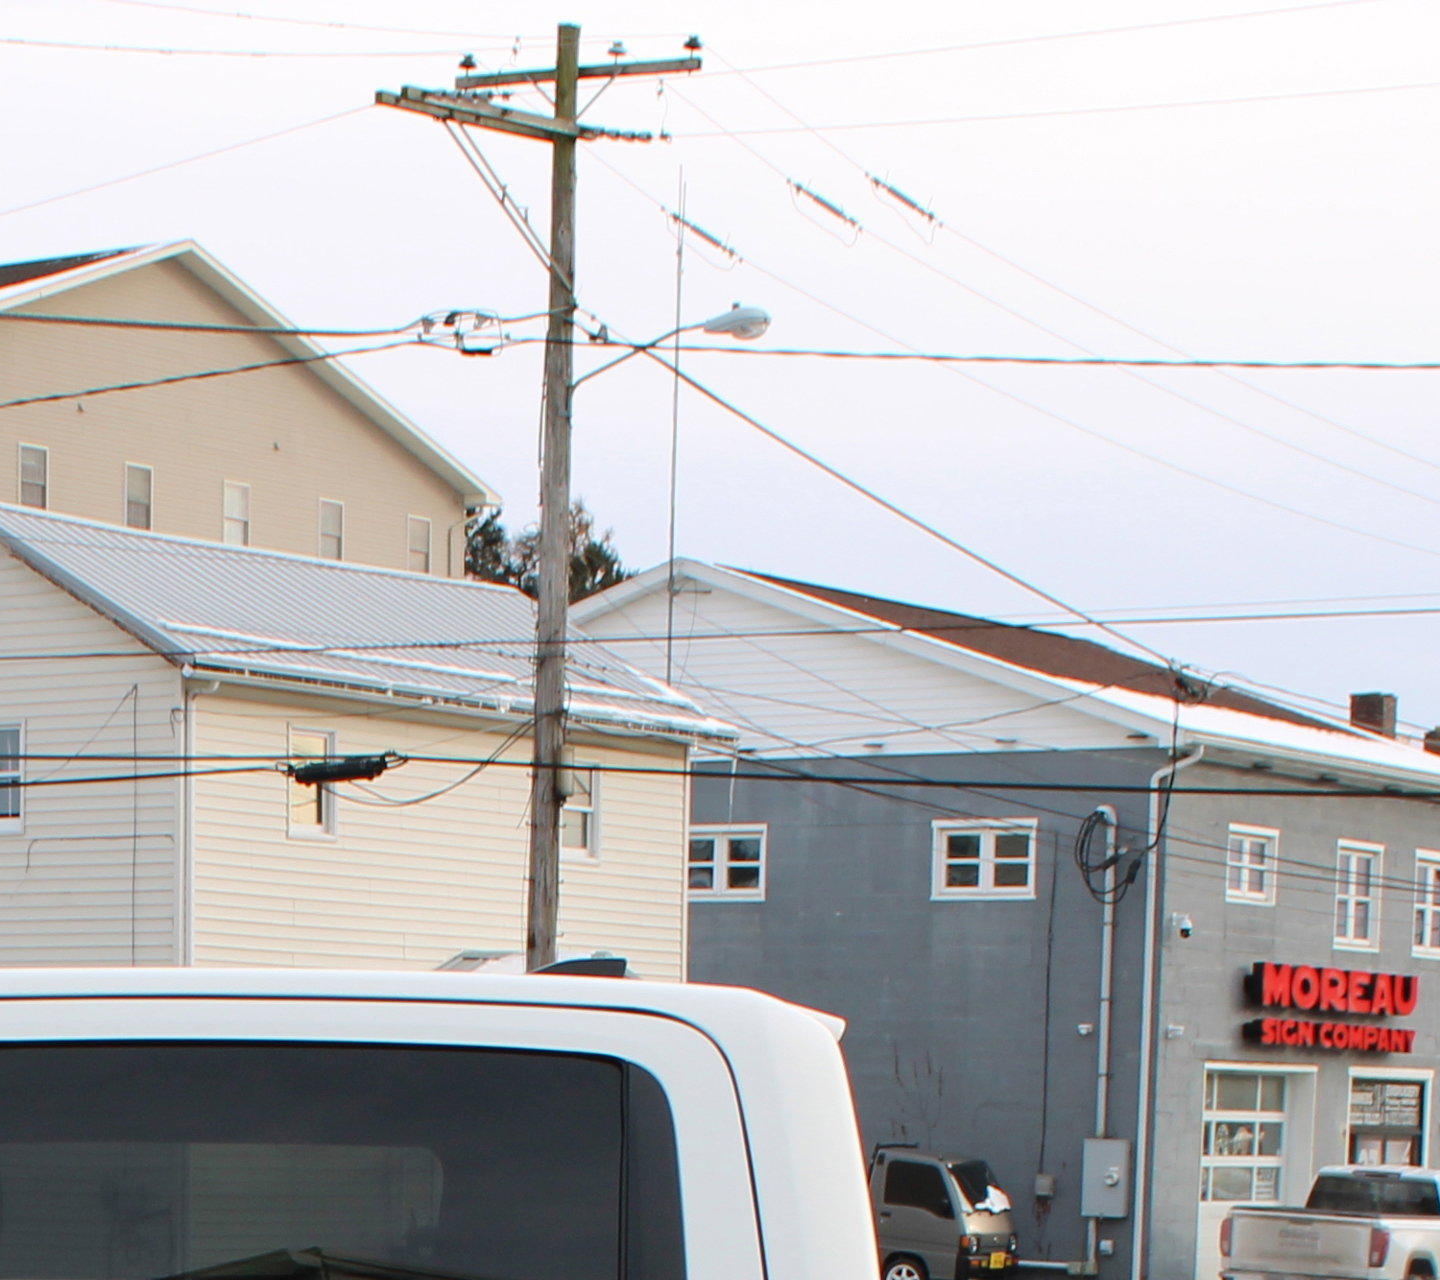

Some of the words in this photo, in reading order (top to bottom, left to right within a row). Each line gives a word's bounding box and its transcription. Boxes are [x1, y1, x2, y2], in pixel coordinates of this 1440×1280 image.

[1262, 961, 1419, 1016] MOREAU
[1261, 1017, 1315, 1046] SIGN
[1319, 1021, 1416, 1054] COMPANY
